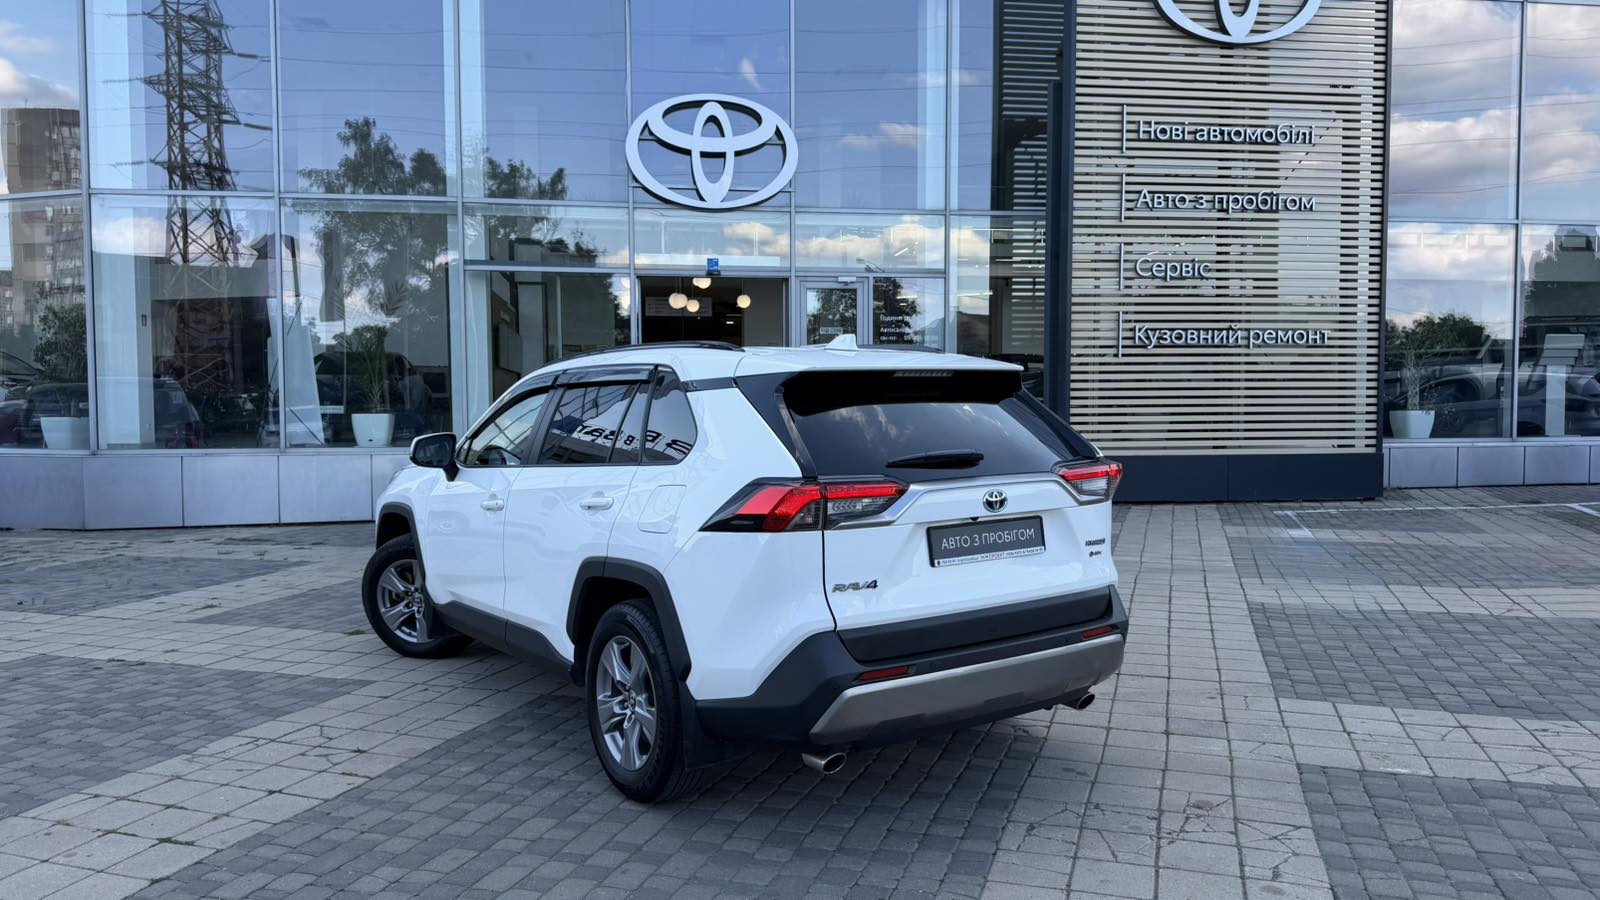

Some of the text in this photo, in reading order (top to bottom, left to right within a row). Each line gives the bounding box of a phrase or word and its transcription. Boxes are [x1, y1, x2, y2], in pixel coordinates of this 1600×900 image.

[1138, 120, 1316, 145] Нові автомобілі
[1136, 188, 1317, 213] Авто з пробігом
[1135, 257, 1212, 282] Сервіс
[1134, 323, 1332, 349] Кузовний ремонт
[941, 528, 1035, 550] АВТО З ПРОБІГОМ
[832, 579, 878, 593] RAV4
